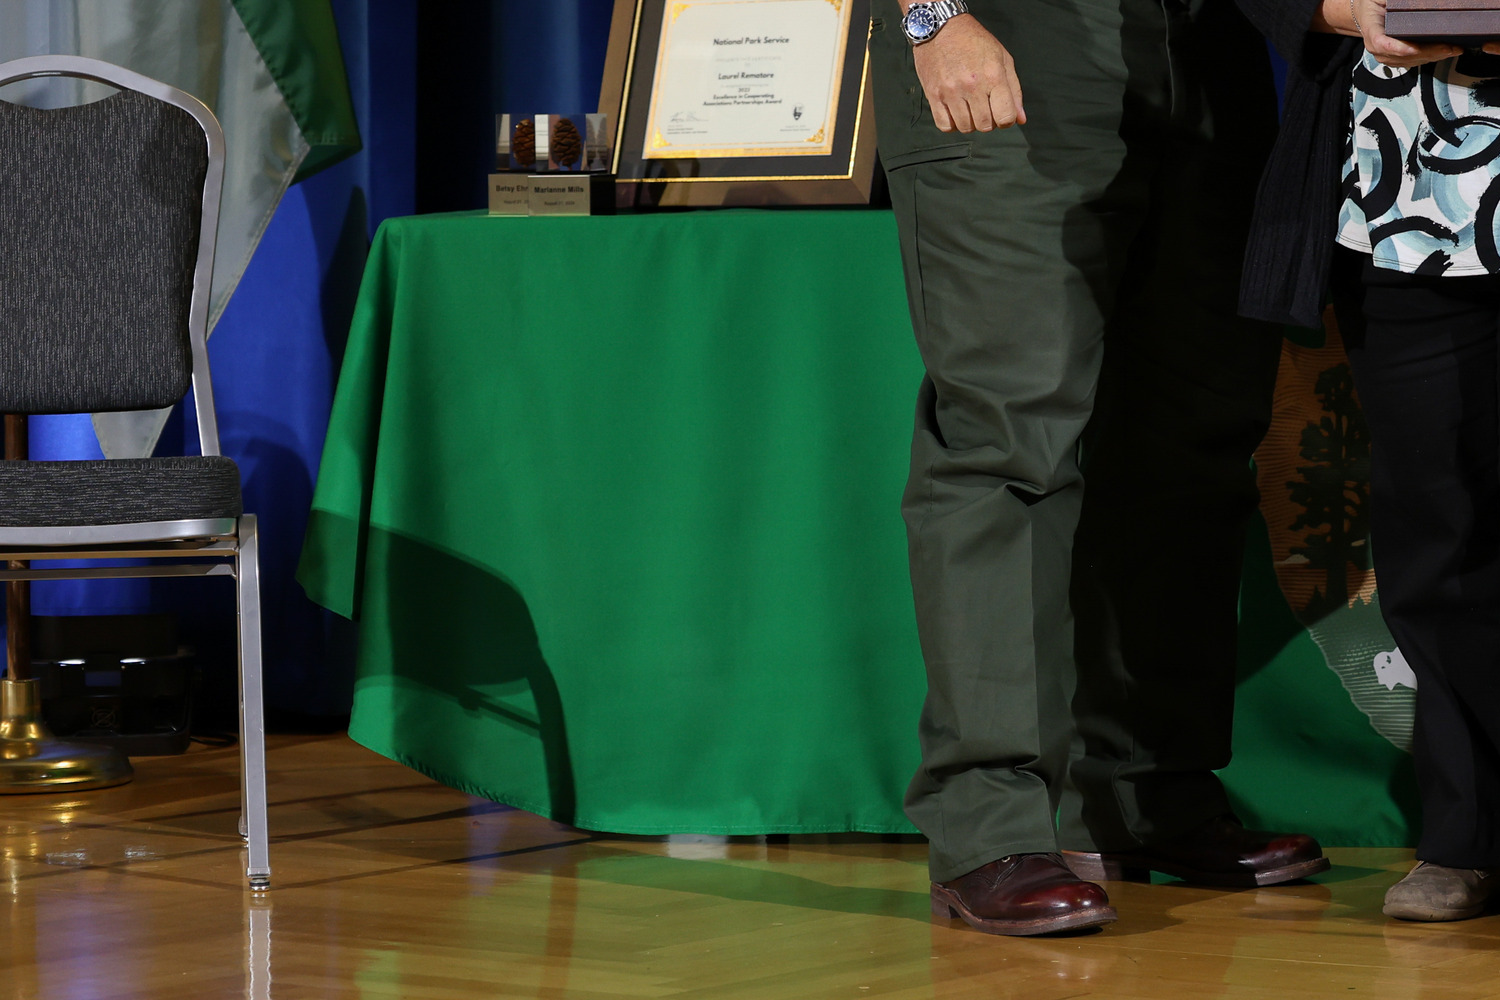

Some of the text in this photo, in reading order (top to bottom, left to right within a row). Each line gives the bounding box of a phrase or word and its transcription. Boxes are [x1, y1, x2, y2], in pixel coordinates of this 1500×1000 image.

[713, 36, 789, 46] National Park Service
[718, 72, 739, 80] Laurel
[495, 185, 515, 193] Betsy
